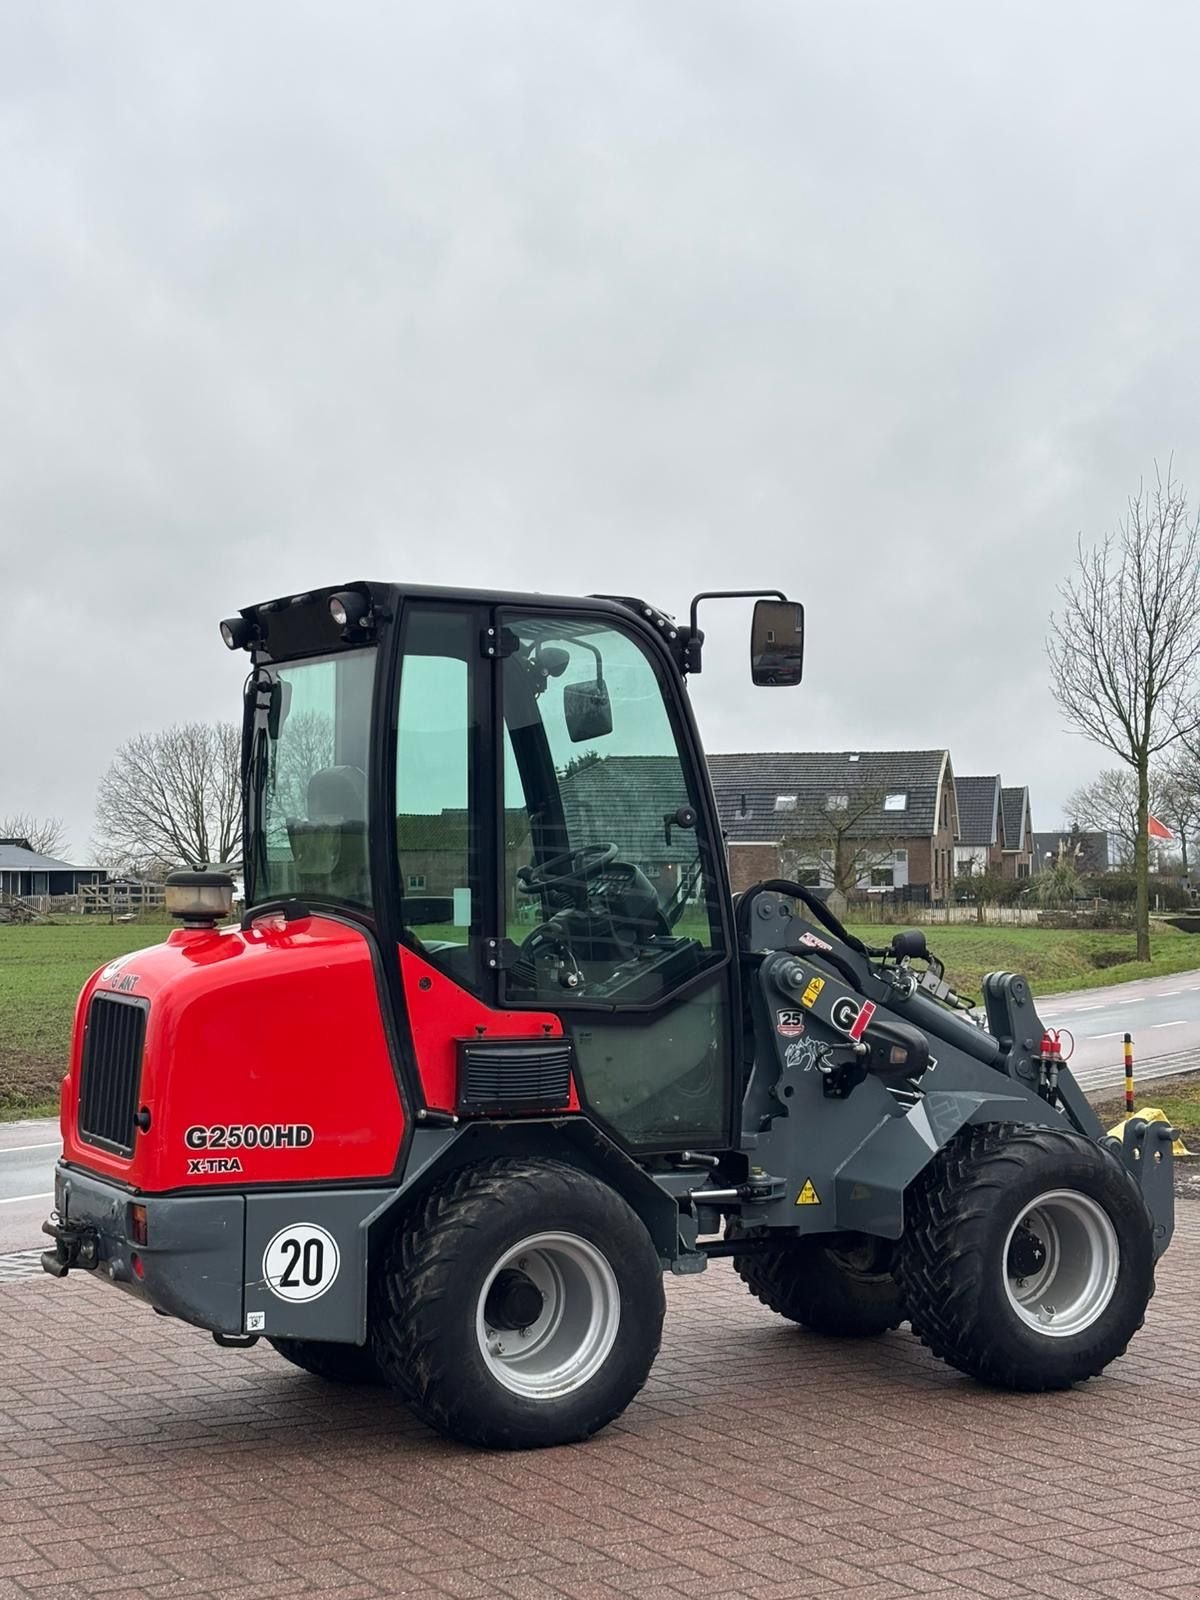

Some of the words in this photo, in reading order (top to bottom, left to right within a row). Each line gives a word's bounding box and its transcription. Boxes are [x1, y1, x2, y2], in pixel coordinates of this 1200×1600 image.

[111, 973, 140, 992] GANT
[781, 1012, 801, 1026] 25
[184, 1124, 315, 1151] G2500HD
[187, 1157, 243, 1175] X-TRA
[279, 1238, 324, 1288] 20
